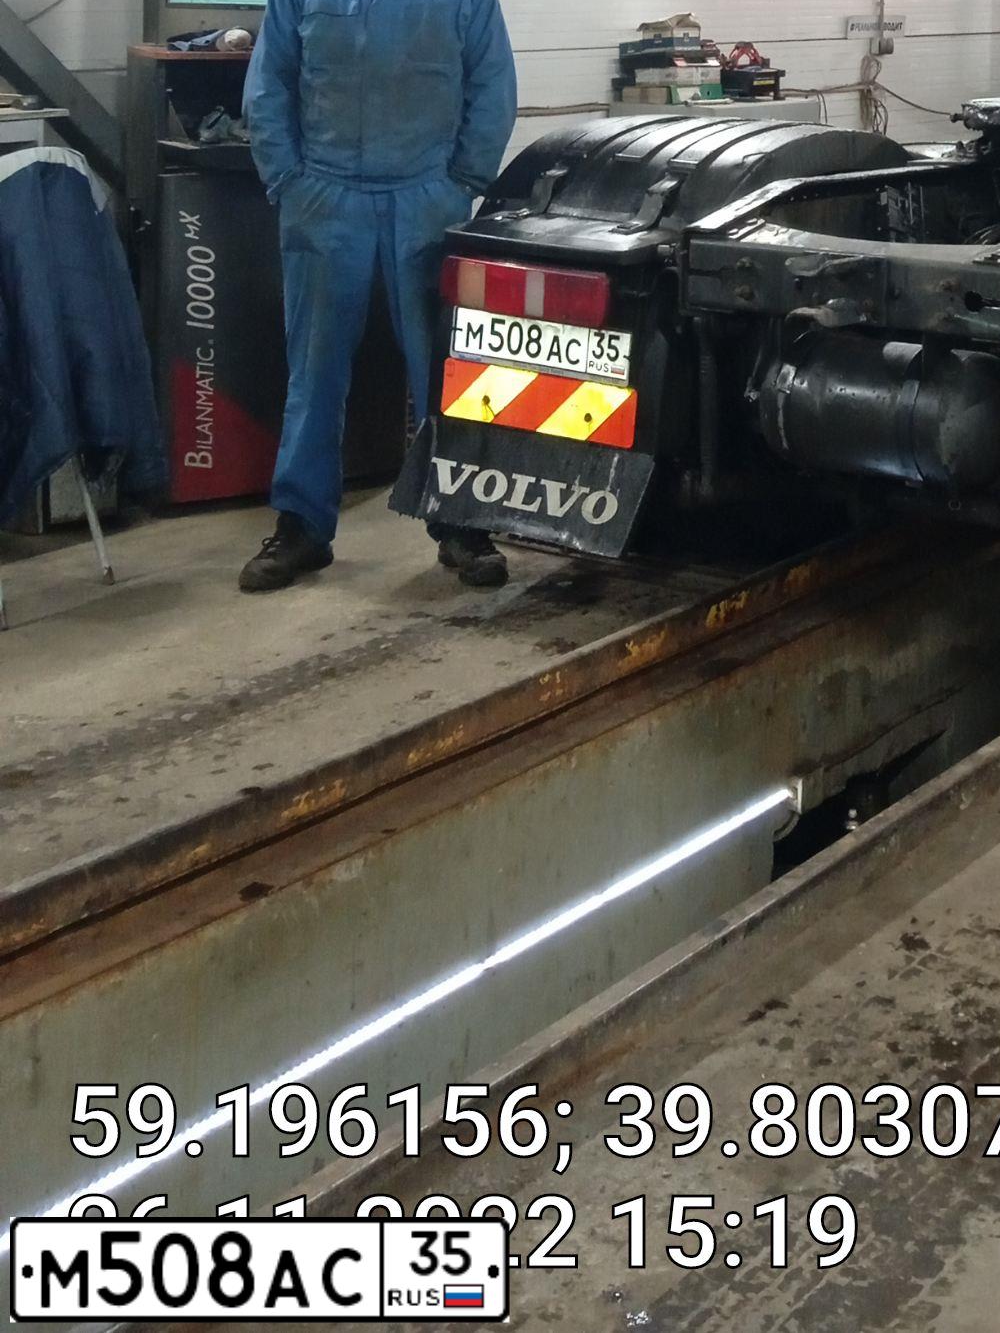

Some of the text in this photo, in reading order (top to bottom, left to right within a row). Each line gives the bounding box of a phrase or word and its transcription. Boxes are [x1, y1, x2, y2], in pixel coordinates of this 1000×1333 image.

[186, 245, 216, 329] 10000
[588, 361, 610, 373] RUS
[592, 332, 621, 362] 35
[431, 457, 619, 525] VOLVO
